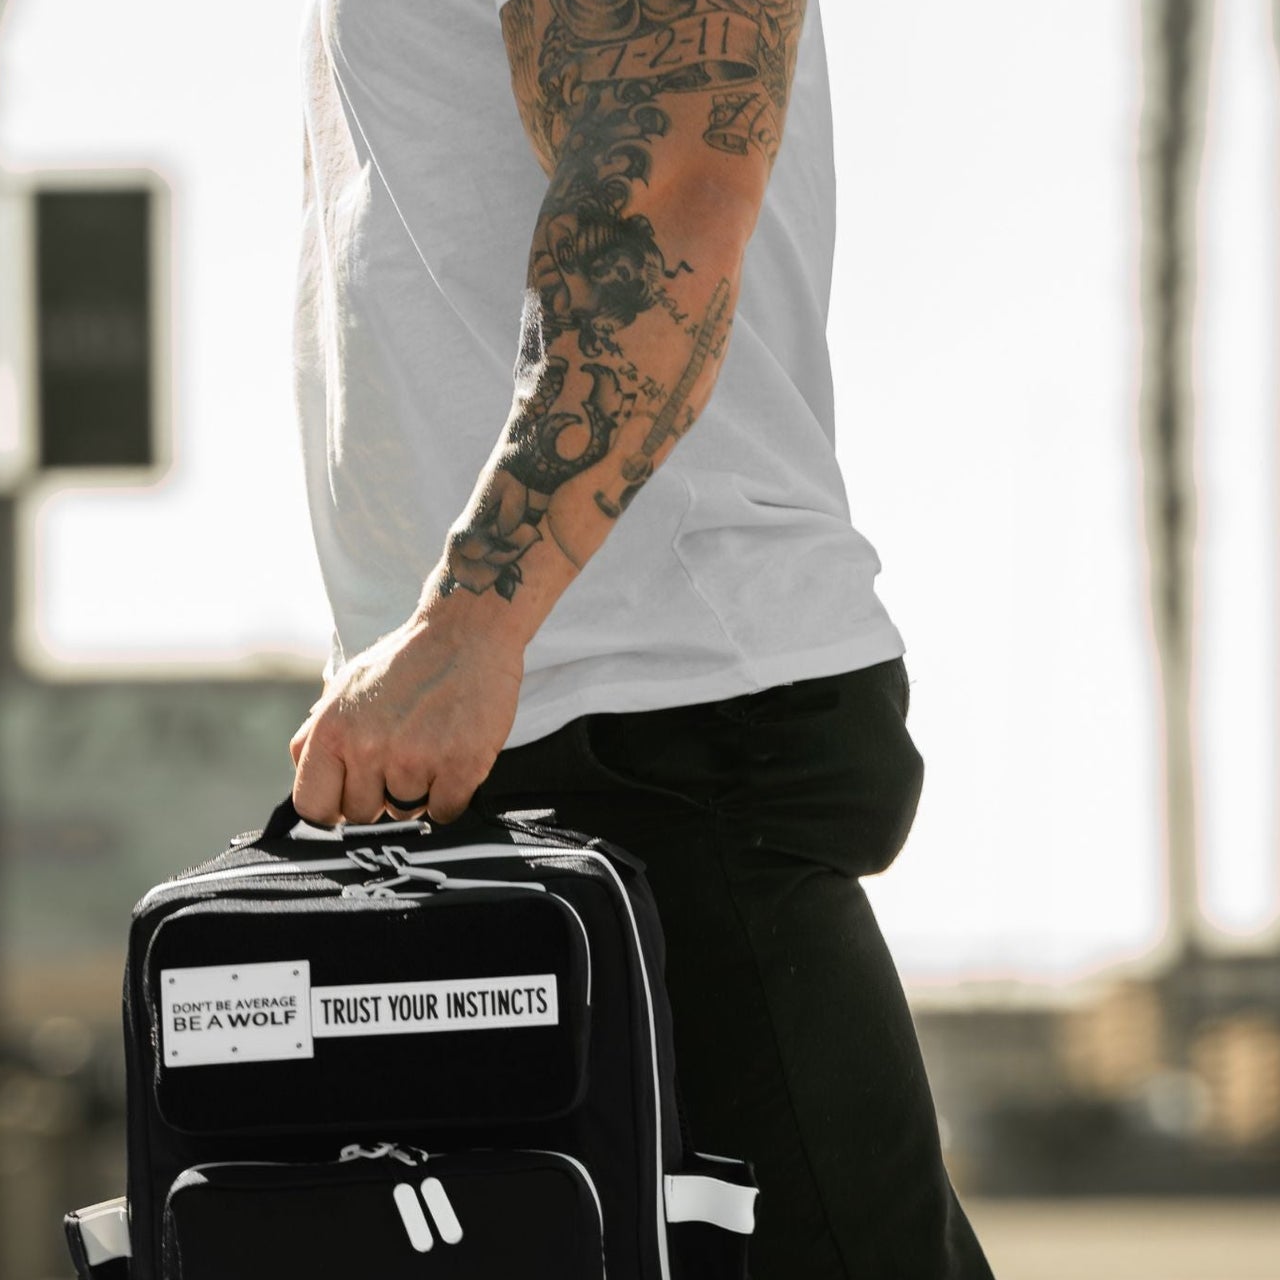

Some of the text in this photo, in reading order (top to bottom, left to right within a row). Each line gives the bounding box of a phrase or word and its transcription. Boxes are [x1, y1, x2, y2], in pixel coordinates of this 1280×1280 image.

[596, 16, 731, 78] 7-2-11
[172, 995, 297, 1014] DON'T BE AVERAGE
[320, 986, 548, 1025] TRUST YOUR INSTINCTS
[173, 1010, 297, 1032] BE A WOLF
